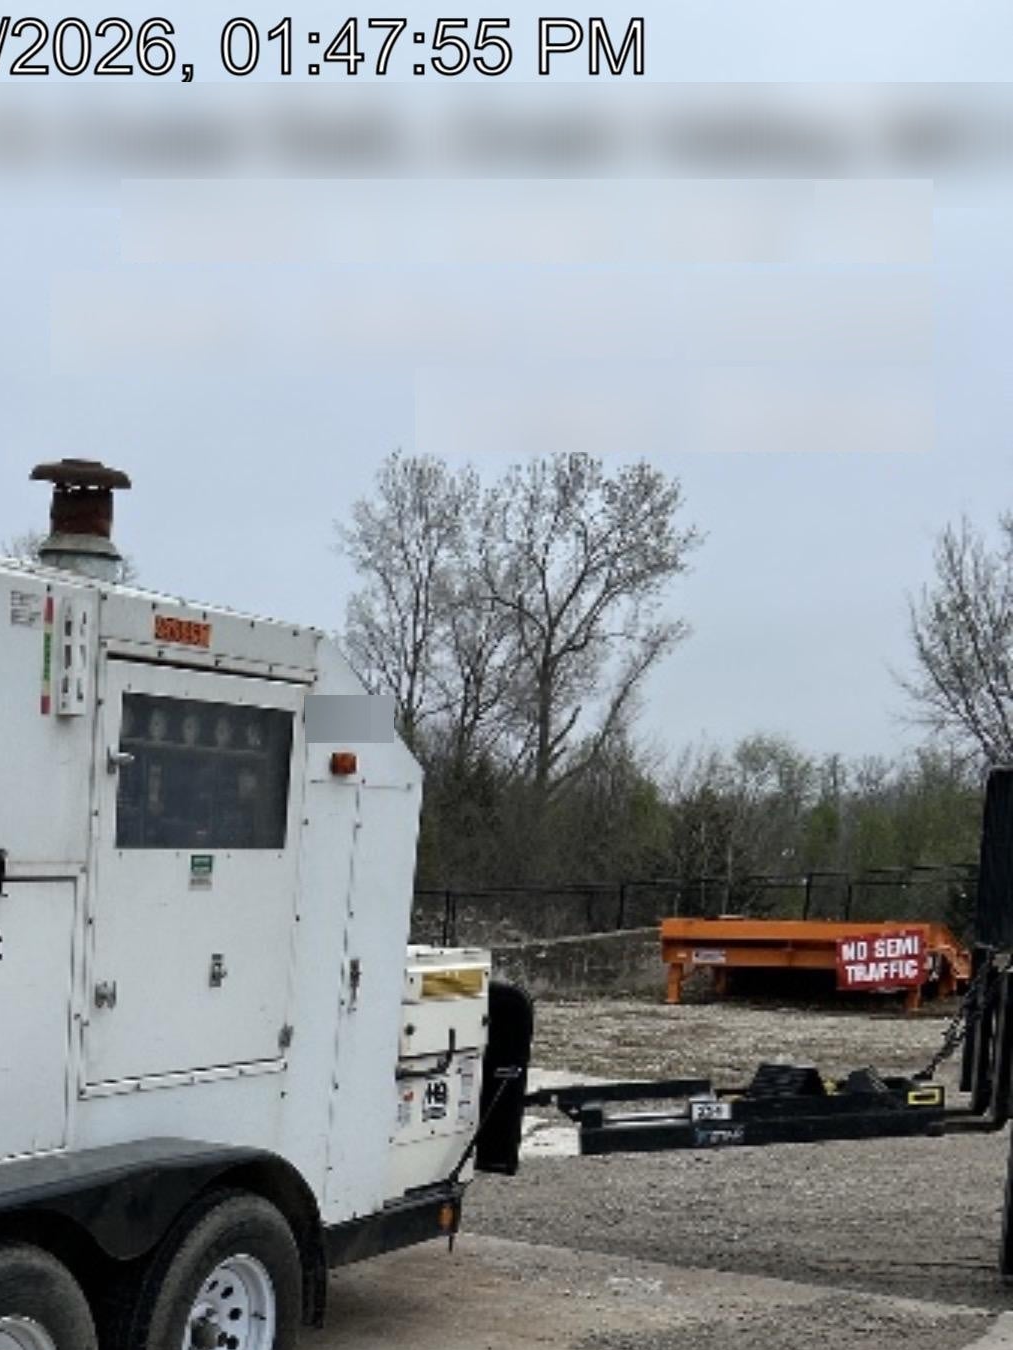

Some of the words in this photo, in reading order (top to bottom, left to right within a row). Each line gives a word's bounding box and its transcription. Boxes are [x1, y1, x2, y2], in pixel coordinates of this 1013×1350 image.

[841, 942, 867, 961] NO
[874, 935, 919, 958] SEMI
[845, 959, 919, 985] TRAFFIC
